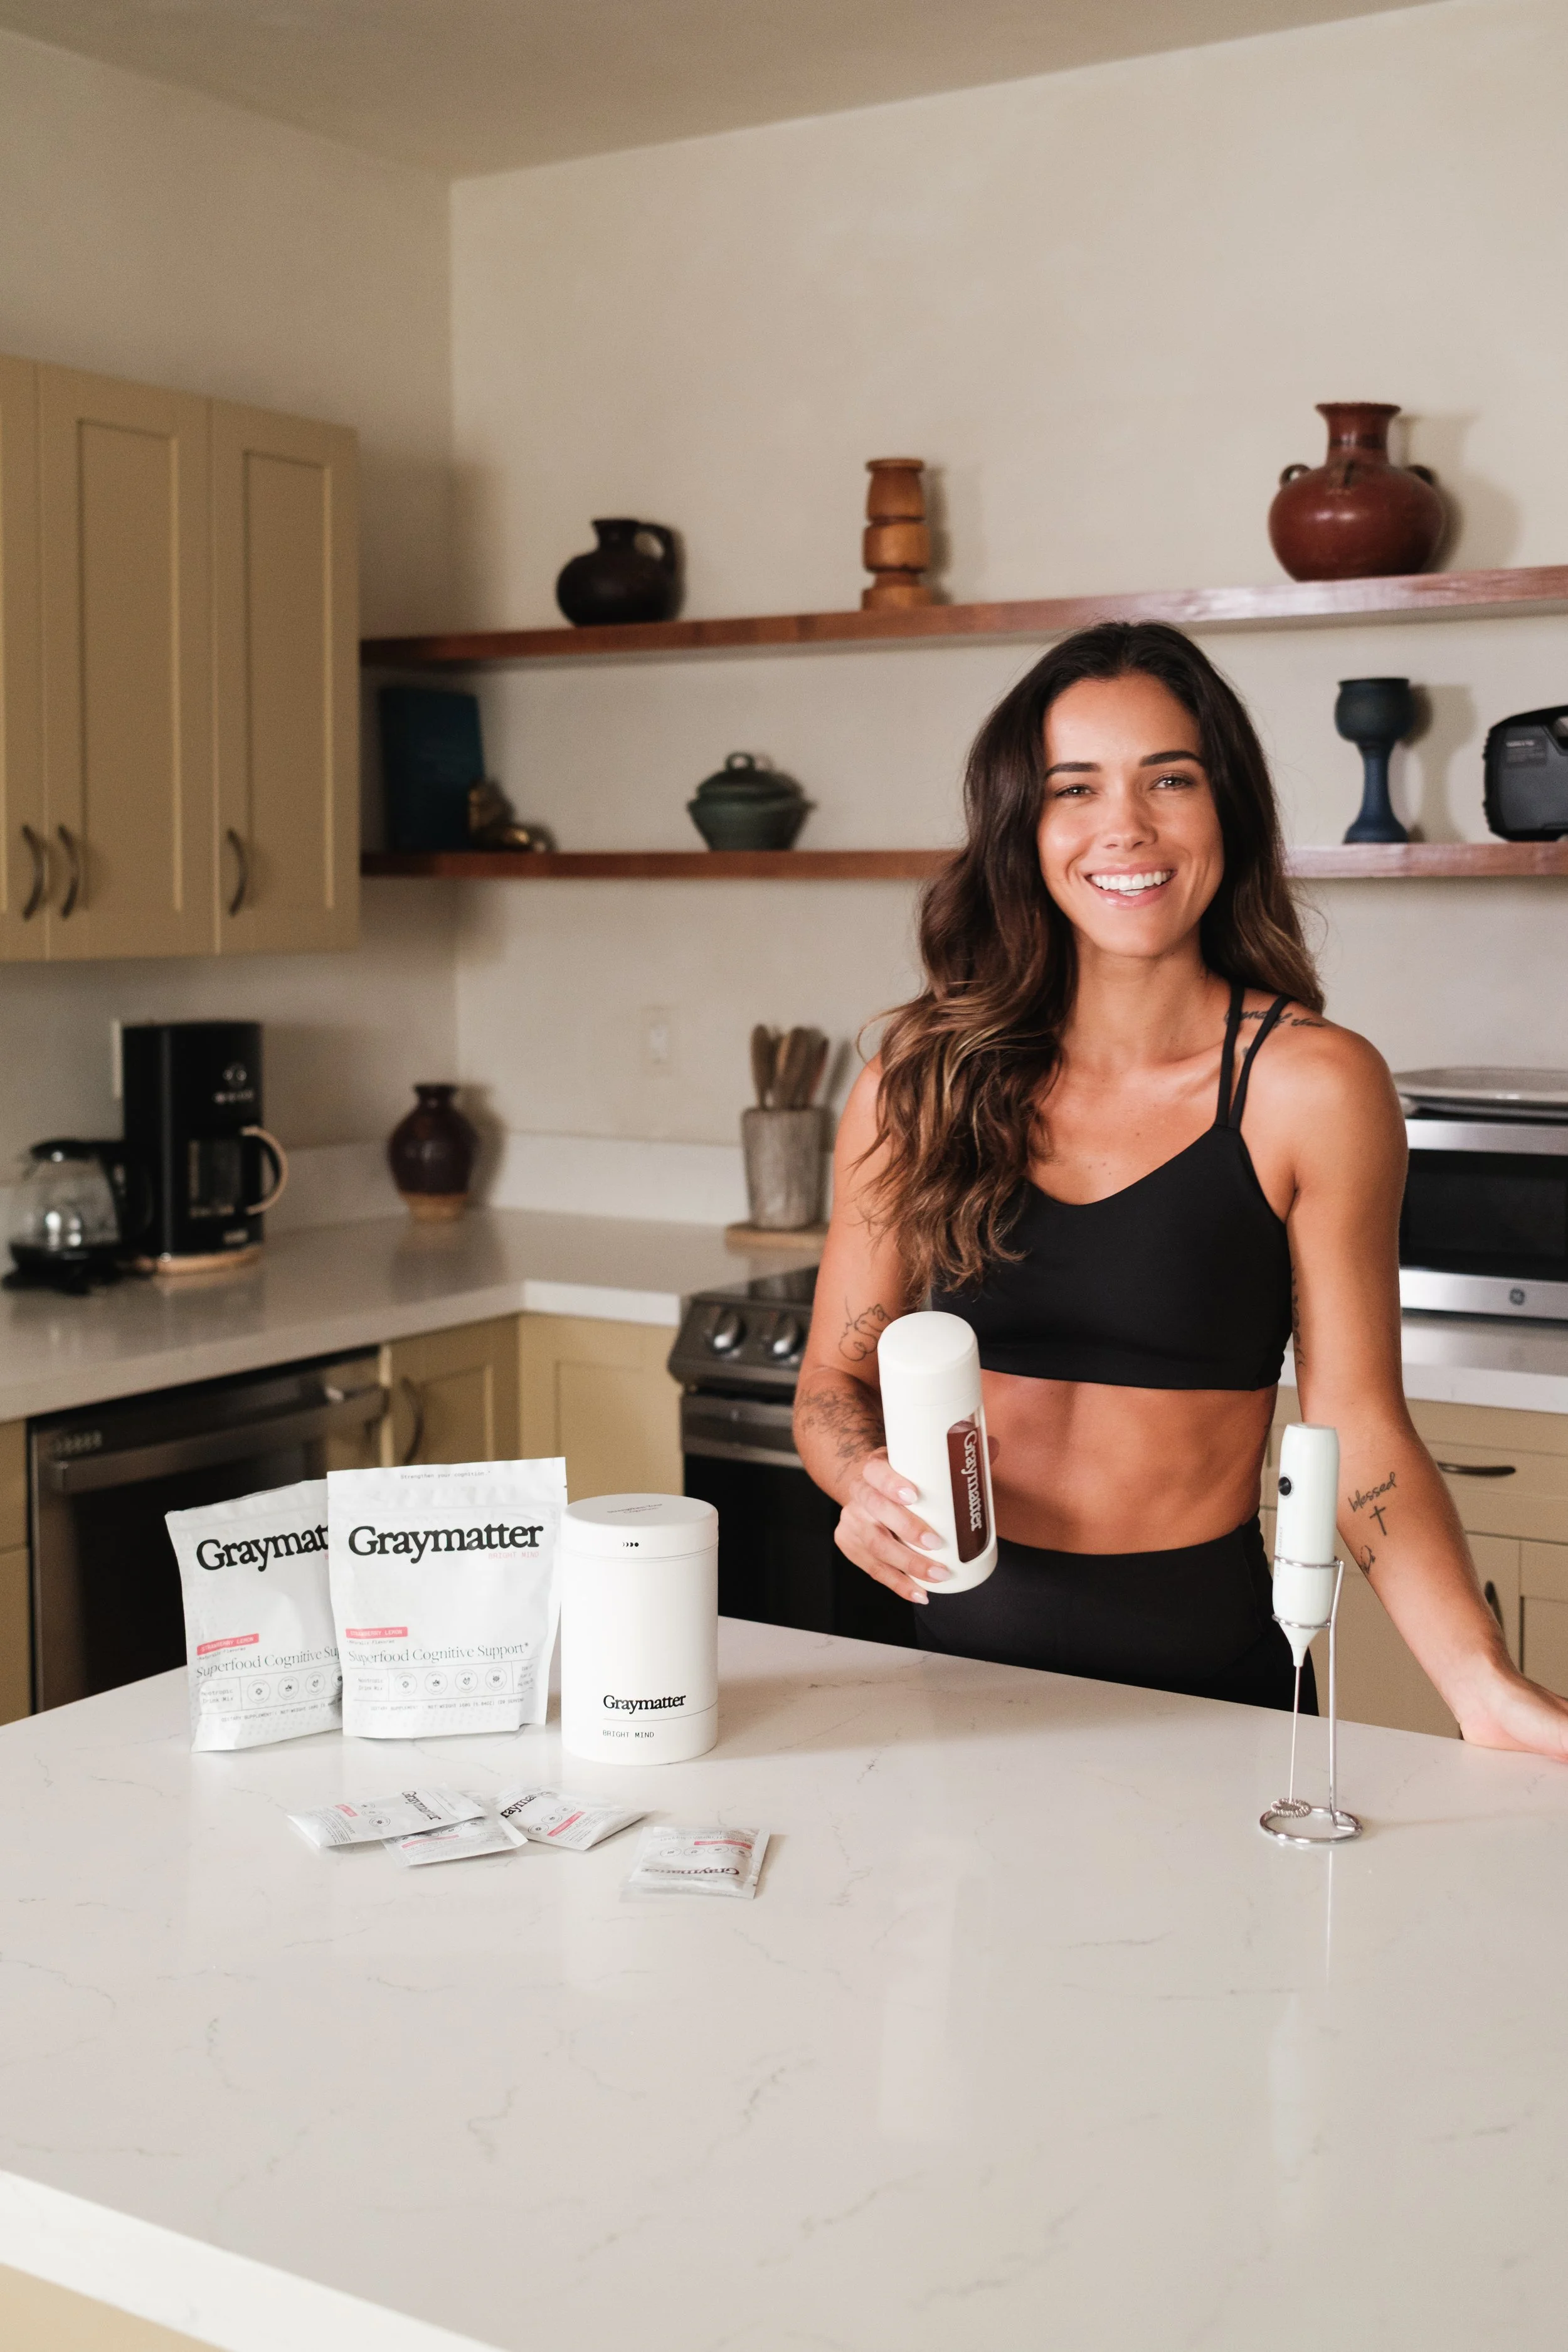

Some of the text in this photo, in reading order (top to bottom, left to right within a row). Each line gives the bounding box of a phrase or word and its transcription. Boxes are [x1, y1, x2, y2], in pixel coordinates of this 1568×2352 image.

[961, 1431, 983, 1532] Graymatter
[1347, 1471, 1396, 1512] blessed
[348, 1523, 544, 1564] Graymatter
[236, 1636, 254, 1645] LEMON
[196, 1655, 262, 1678] Superfood
[265, 1650, 322, 1668] Cognitive
[348, 1649, 409, 1665] Superfood
[413, 1646, 474, 1664] Cognitive
[603, 1695, 687, 1715] Graymatter
[603, 1730, 630, 1738] BRIGHT
